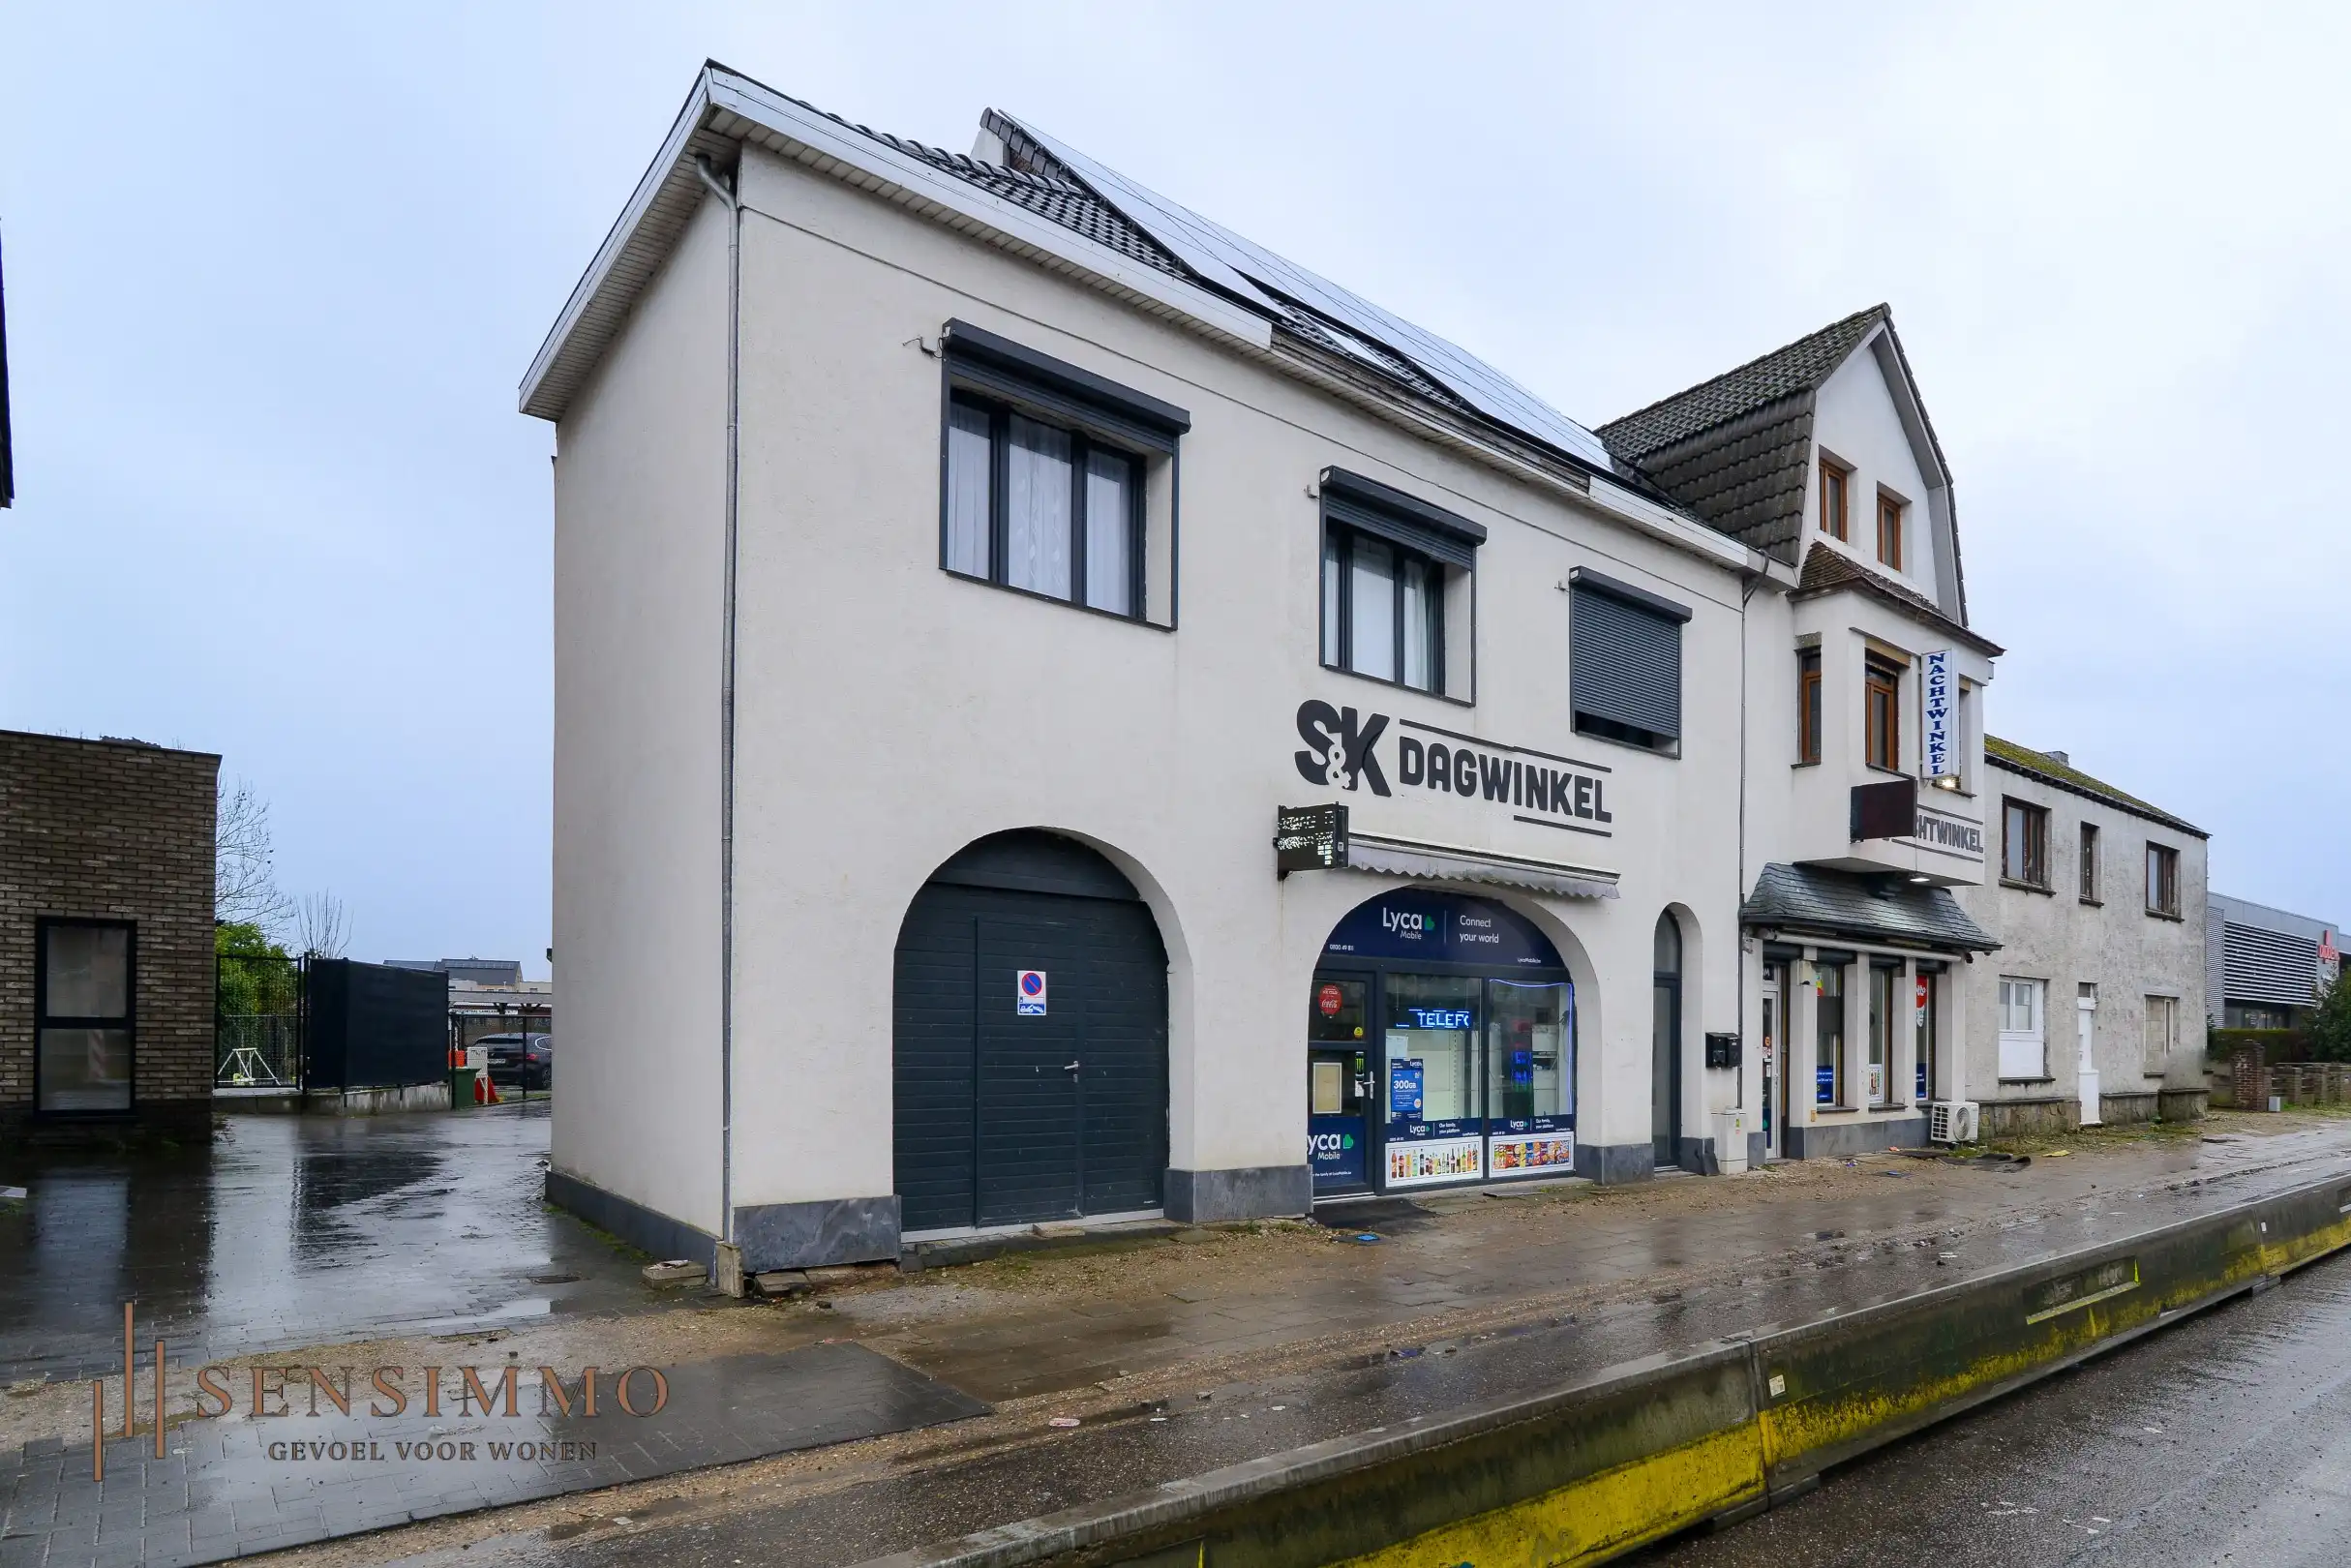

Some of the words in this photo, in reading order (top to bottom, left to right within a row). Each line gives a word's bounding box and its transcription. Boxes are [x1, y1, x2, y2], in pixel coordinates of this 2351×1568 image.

[1926, 652, 1949, 774] NACHTWINKEL
[1400, 736, 1613, 823] DAGWINKEL
[1917, 815, 1984, 854] HTWINKEL
[1382, 907, 1423, 932] Lyca
[1460, 915, 1492, 927] Connect
[1400, 929, 1423, 940] Mobile
[1460, 932, 1477, 943] your
[1478, 933, 1499, 944] world
[1394, 1079, 1417, 1089] 300GB
[1409, 1125, 1426, 1134] Lyca
[1307, 1133, 1341, 1155] yca
[1317, 1151, 1341, 1161] Mobile
